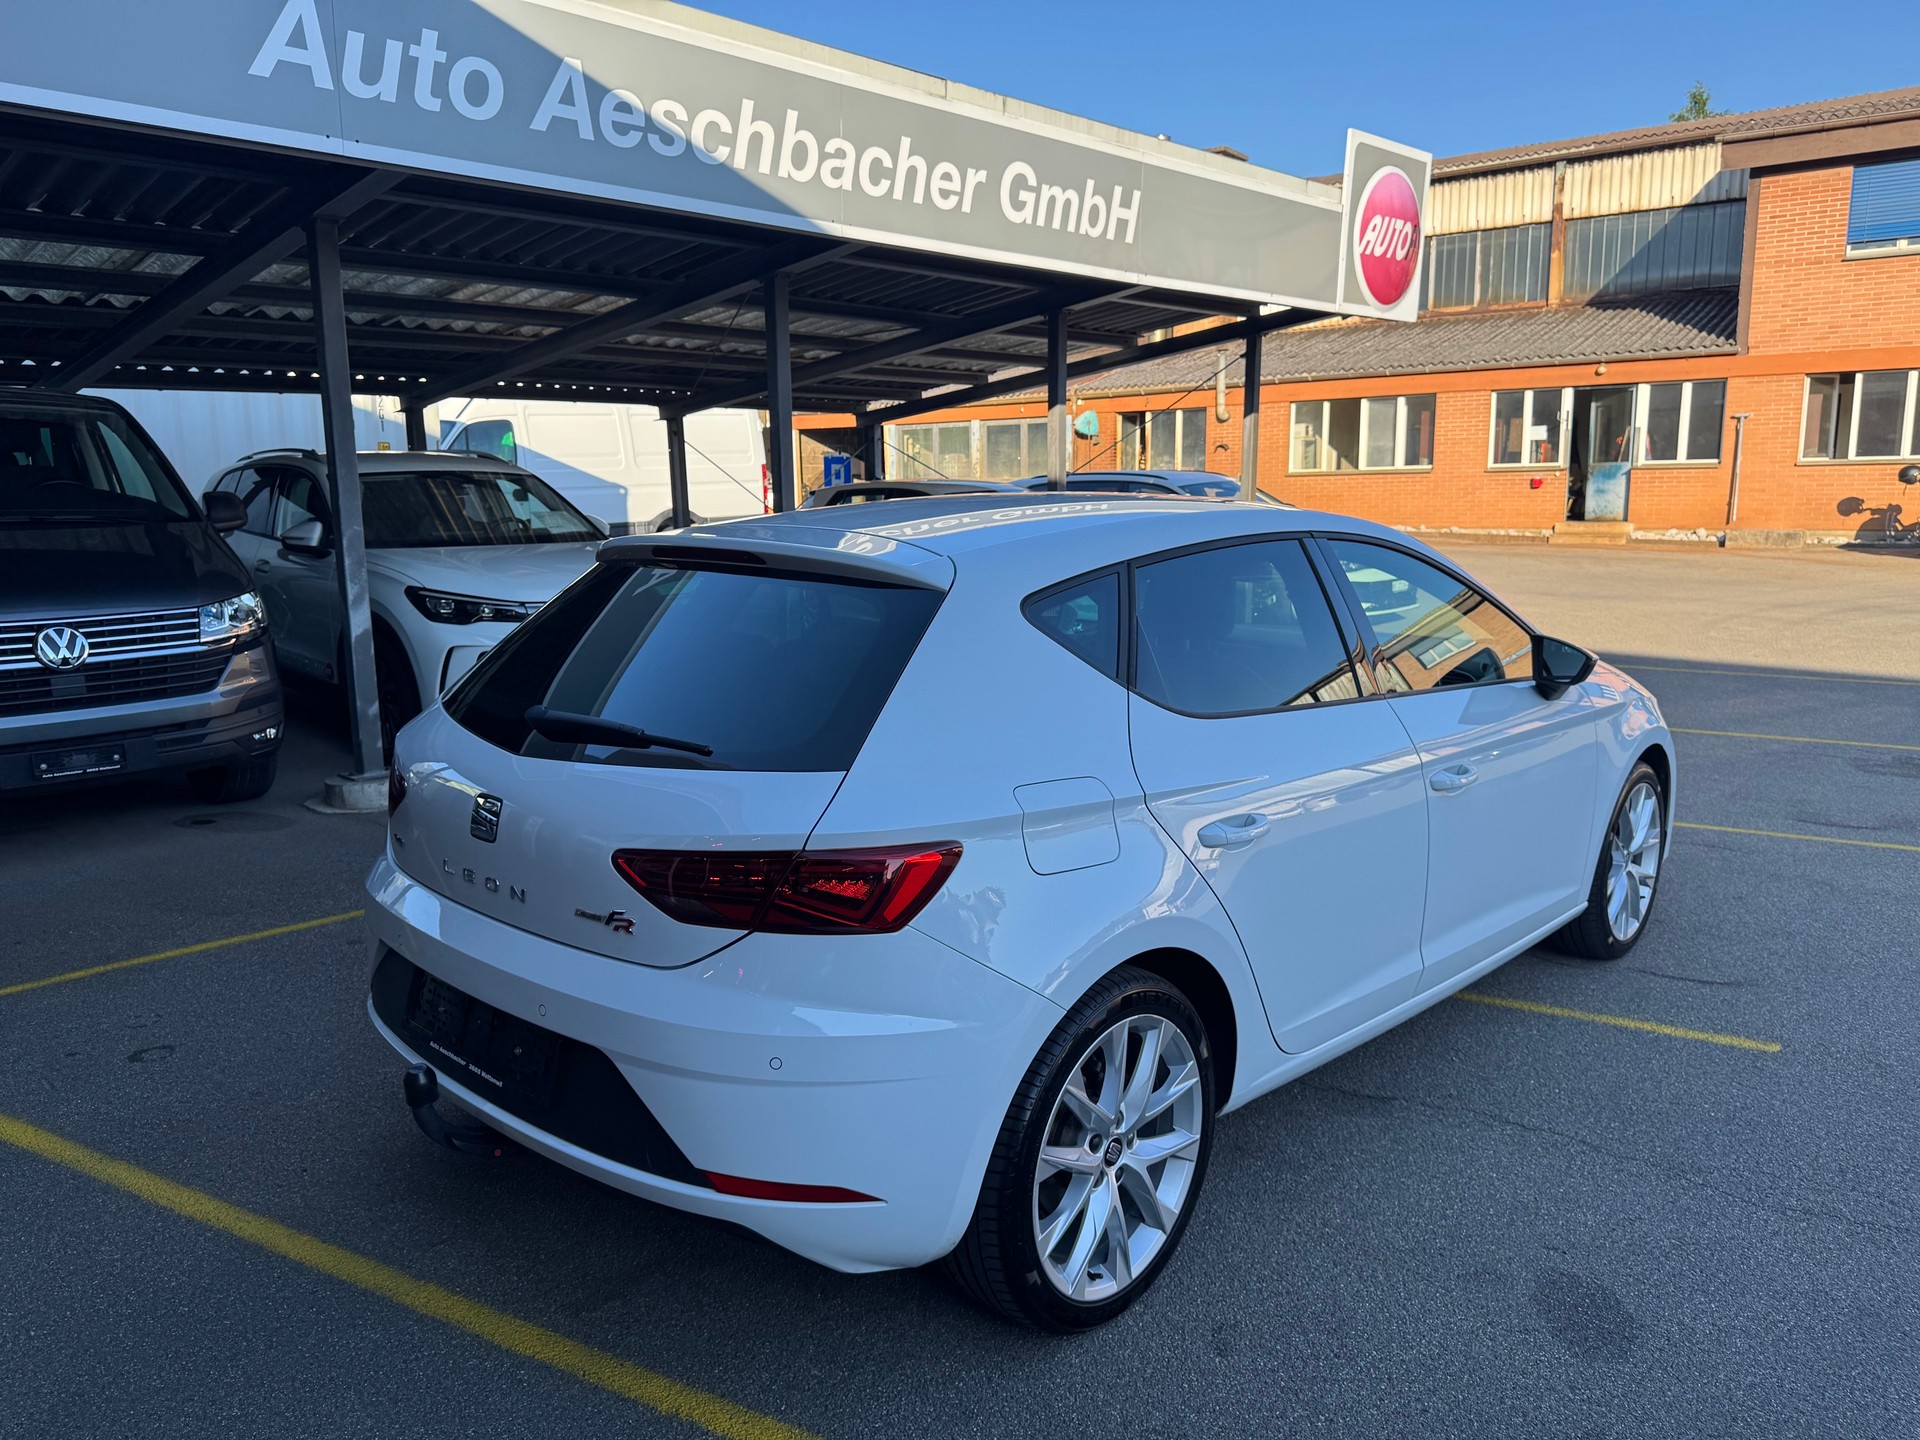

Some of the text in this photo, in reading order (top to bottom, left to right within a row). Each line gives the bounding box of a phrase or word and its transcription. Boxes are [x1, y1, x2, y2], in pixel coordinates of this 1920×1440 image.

[248, 0, 1141, 244] Auto Aeschbacher GmbH
[443, 858, 527, 904] LEON
